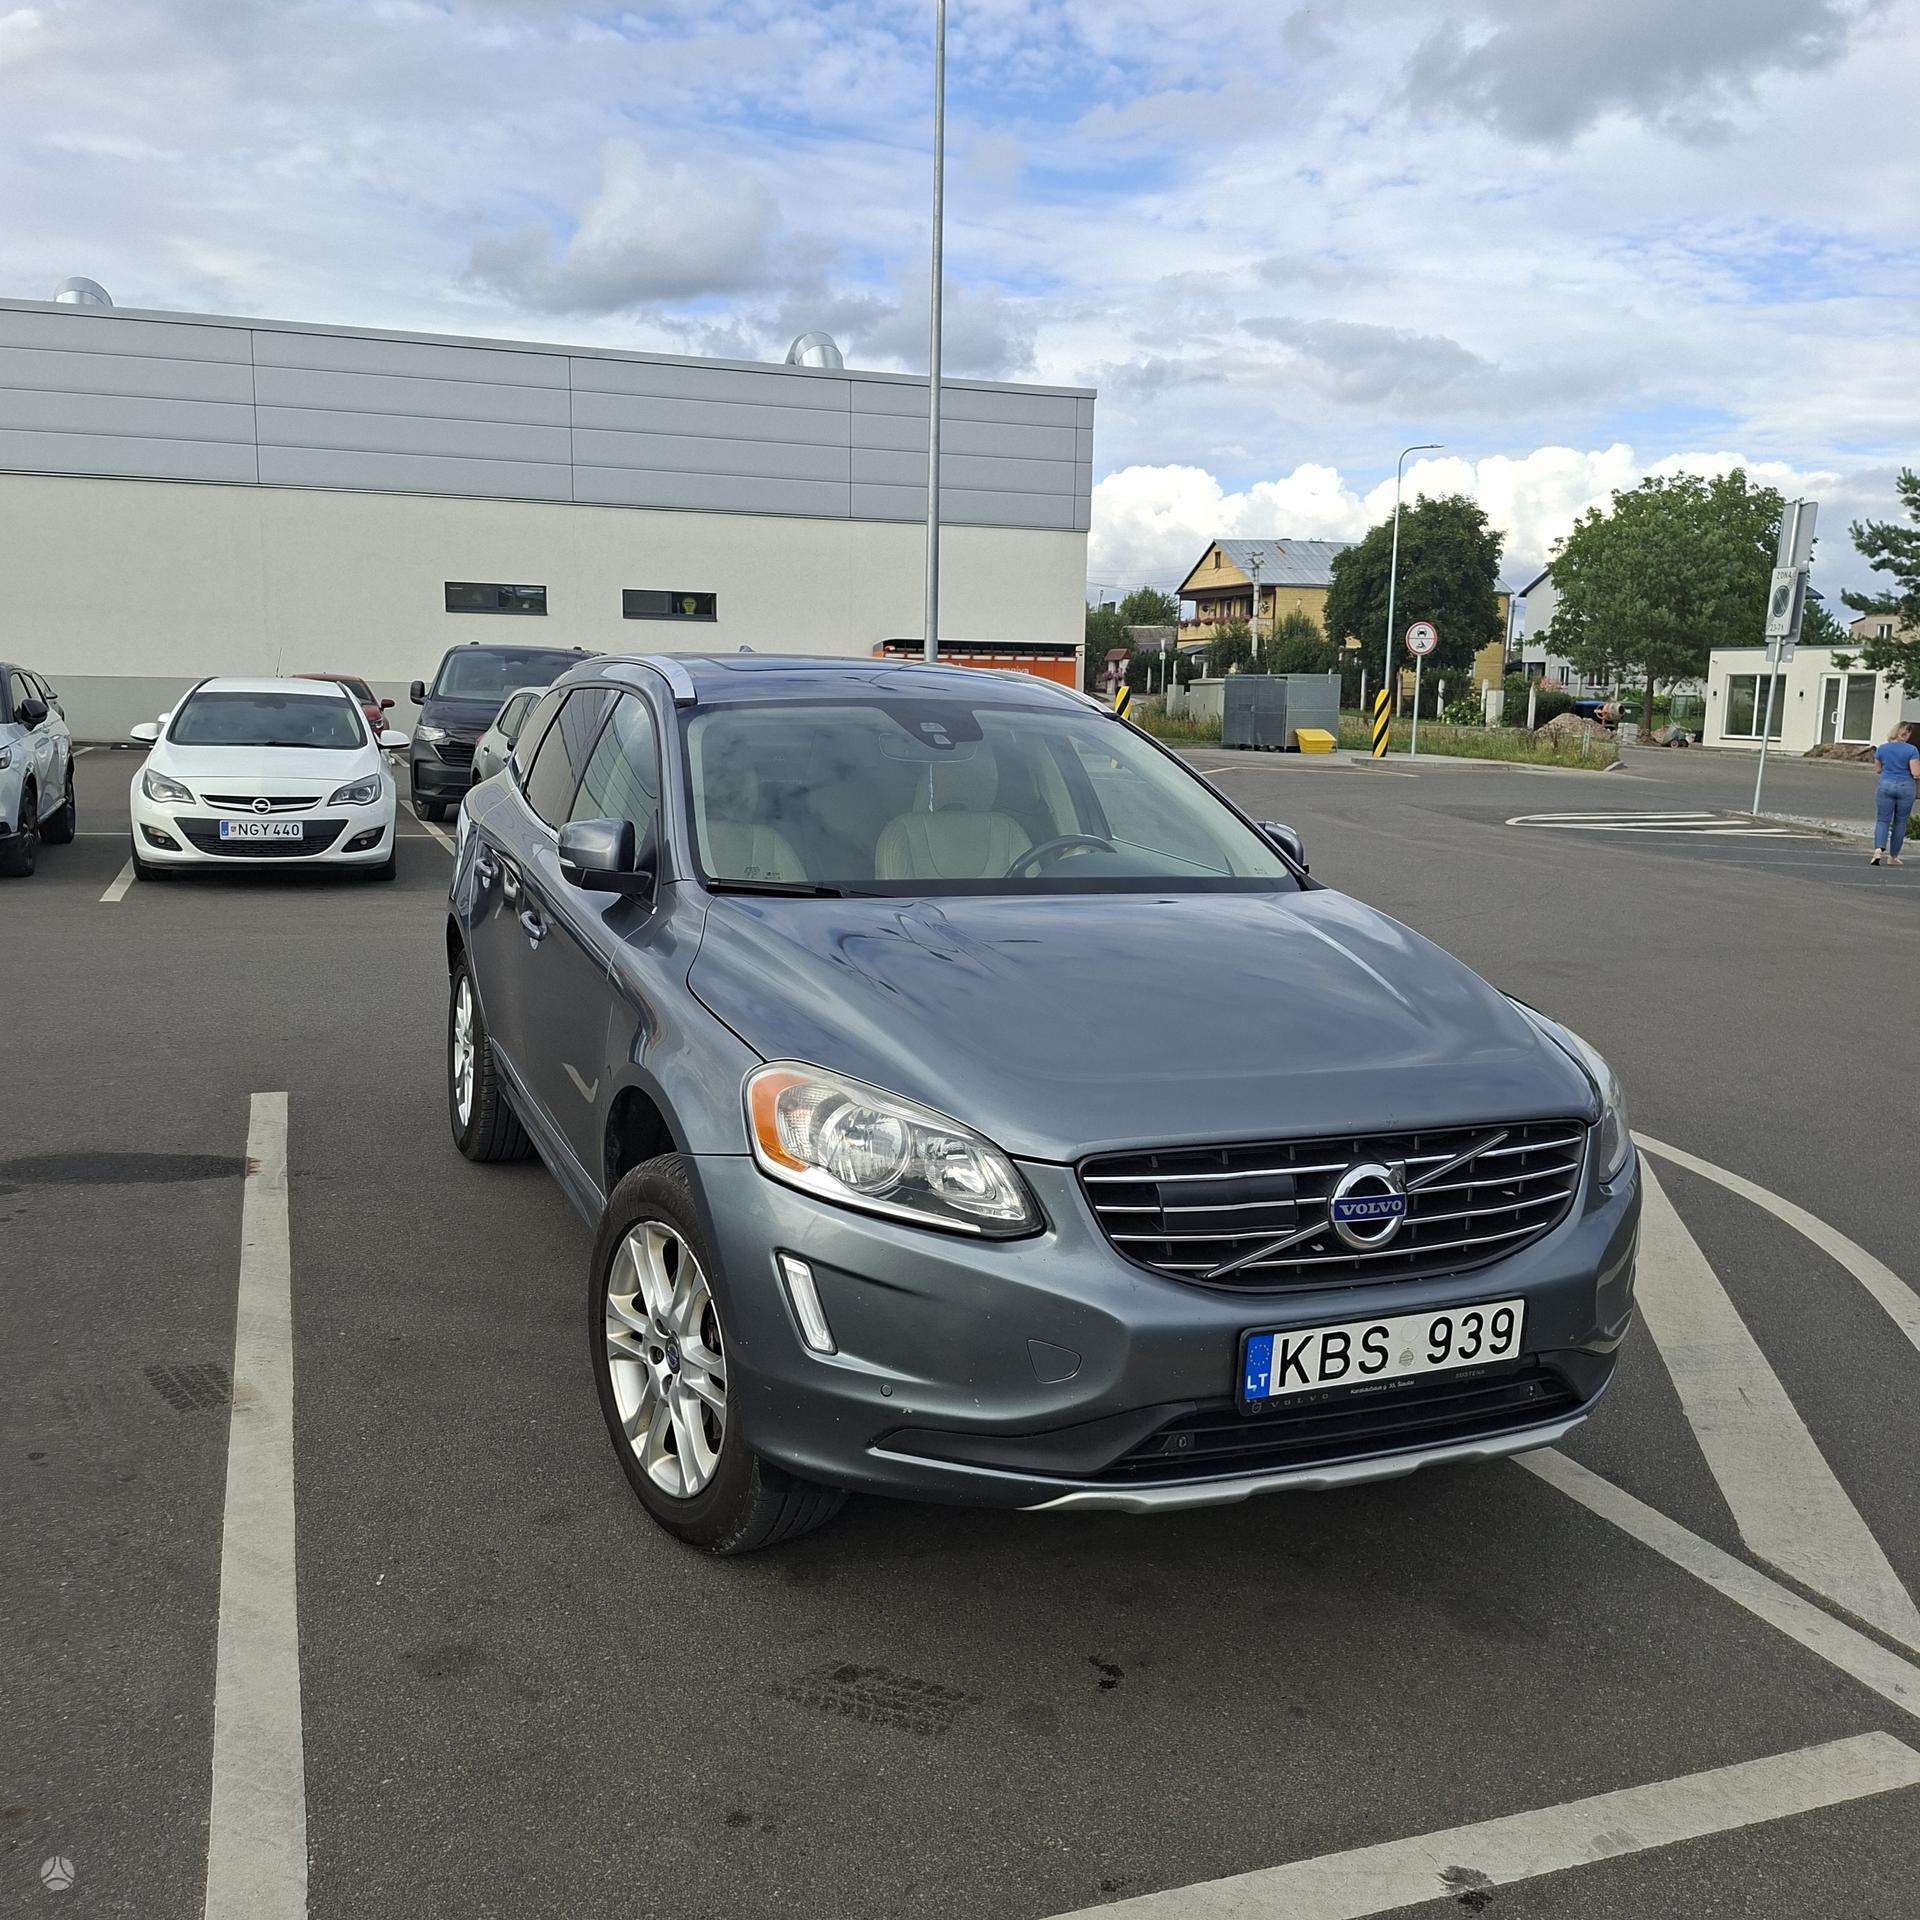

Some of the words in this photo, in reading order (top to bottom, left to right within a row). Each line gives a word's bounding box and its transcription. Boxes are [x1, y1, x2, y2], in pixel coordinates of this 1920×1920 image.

[1776, 571, 1792, 579] ZONA
[238, 823, 269, 836] NGY
[273, 823, 300, 836] 440
[1339, 1200, 1402, 1216] VOLVO
[1278, 1325, 1390, 1388] KBS
[1426, 1307, 1515, 1364] 939
[1247, 1373, 1268, 1391] LT
